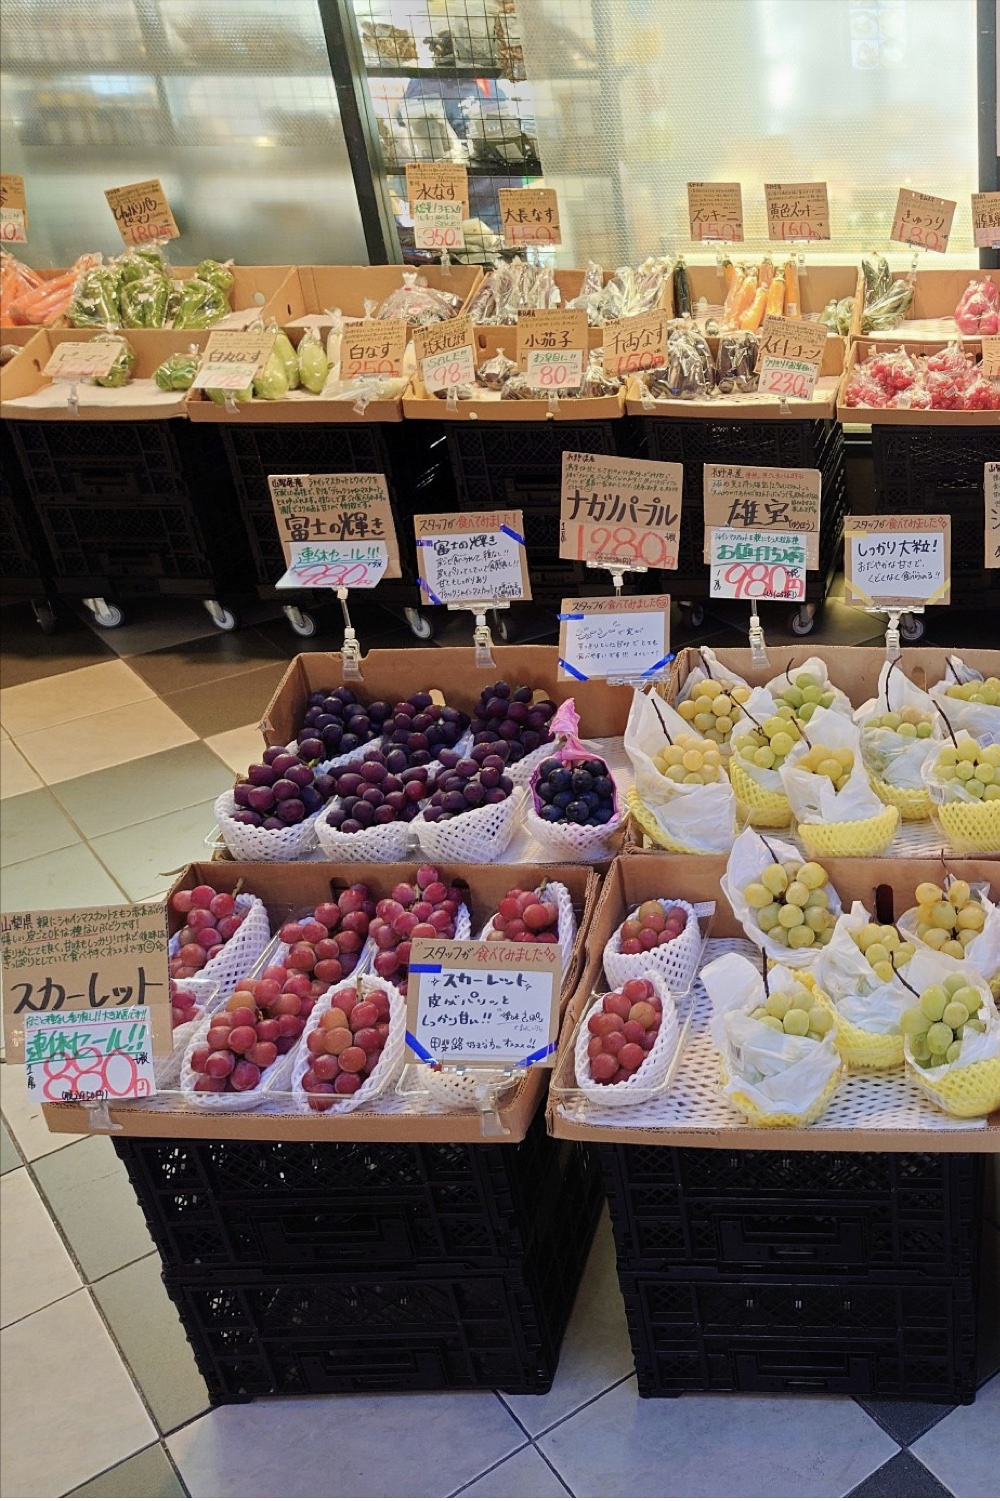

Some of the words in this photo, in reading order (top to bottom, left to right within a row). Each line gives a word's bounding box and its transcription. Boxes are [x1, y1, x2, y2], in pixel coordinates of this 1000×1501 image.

[416, 183, 459, 200] 水なす
[504, 207, 554, 224] 大長なす
[692, 208, 739, 223] ズッキーニ
[770, 200, 826, 219] 黄色ズッキーニ
[901, 209, 945, 231] きゅうり
[605, 323, 665, 355] 千両なす
[208, 348, 264, 364] 白丸なす
[349, 341, 393, 360] 白なす
[566, 489, 679, 527] ナガノパープル
[726, 498, 790, 527] 雄宝
[284, 511, 385, 541] 富士の輝き
[433, 533, 498, 556] 富士の輝き
[857, 539, 938, 558] しっかり大粒!
[422, 944, 544, 964] スタッフが食べてみました
[442, 972, 528, 988] スカーレット
[10, 966, 164, 1014] スカーレット
[427, 991, 510, 1009] 皮がパリッと
[420, 1010, 493, 1028] しっかり甘い!!
[26, 1023, 147, 1064] 連休セール!!
[42, 1046, 151, 1102] 880円
